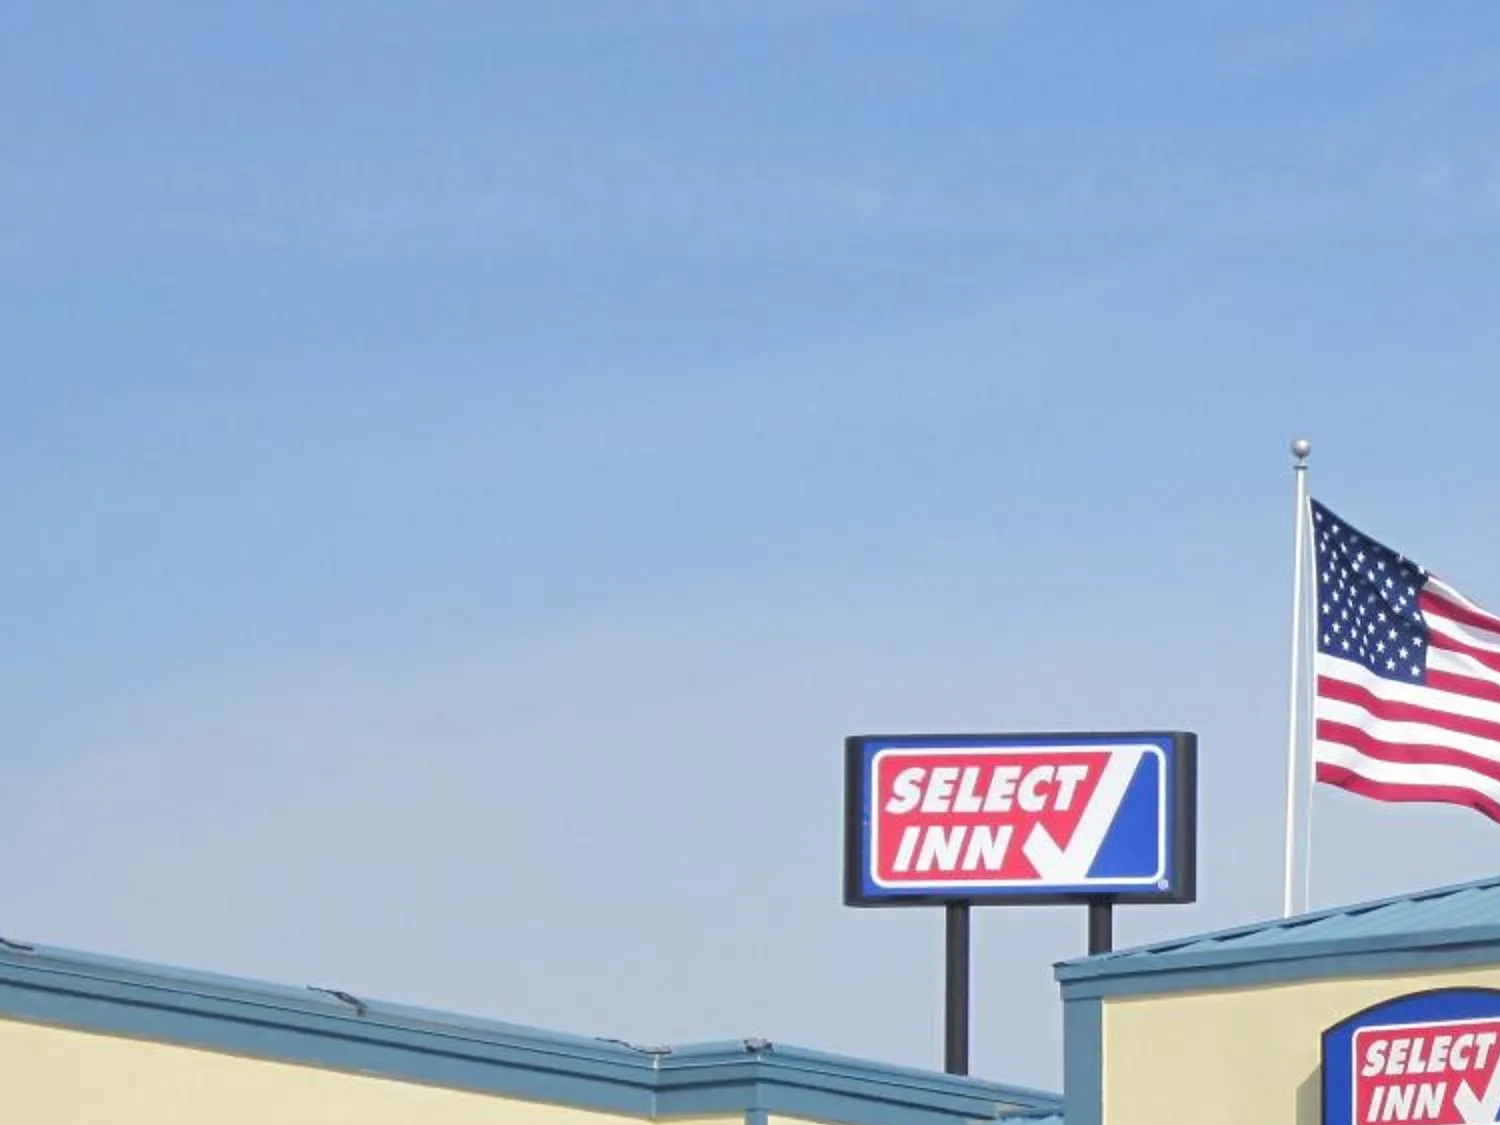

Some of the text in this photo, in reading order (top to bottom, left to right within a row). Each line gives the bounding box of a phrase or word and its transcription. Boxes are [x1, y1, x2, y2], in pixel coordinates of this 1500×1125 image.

[885, 765, 1089, 815] SELECT
[892, 825, 1015, 872] INN
[1361, 1032, 1498, 1077] SELECT
[1366, 1082, 1447, 1122] INN
